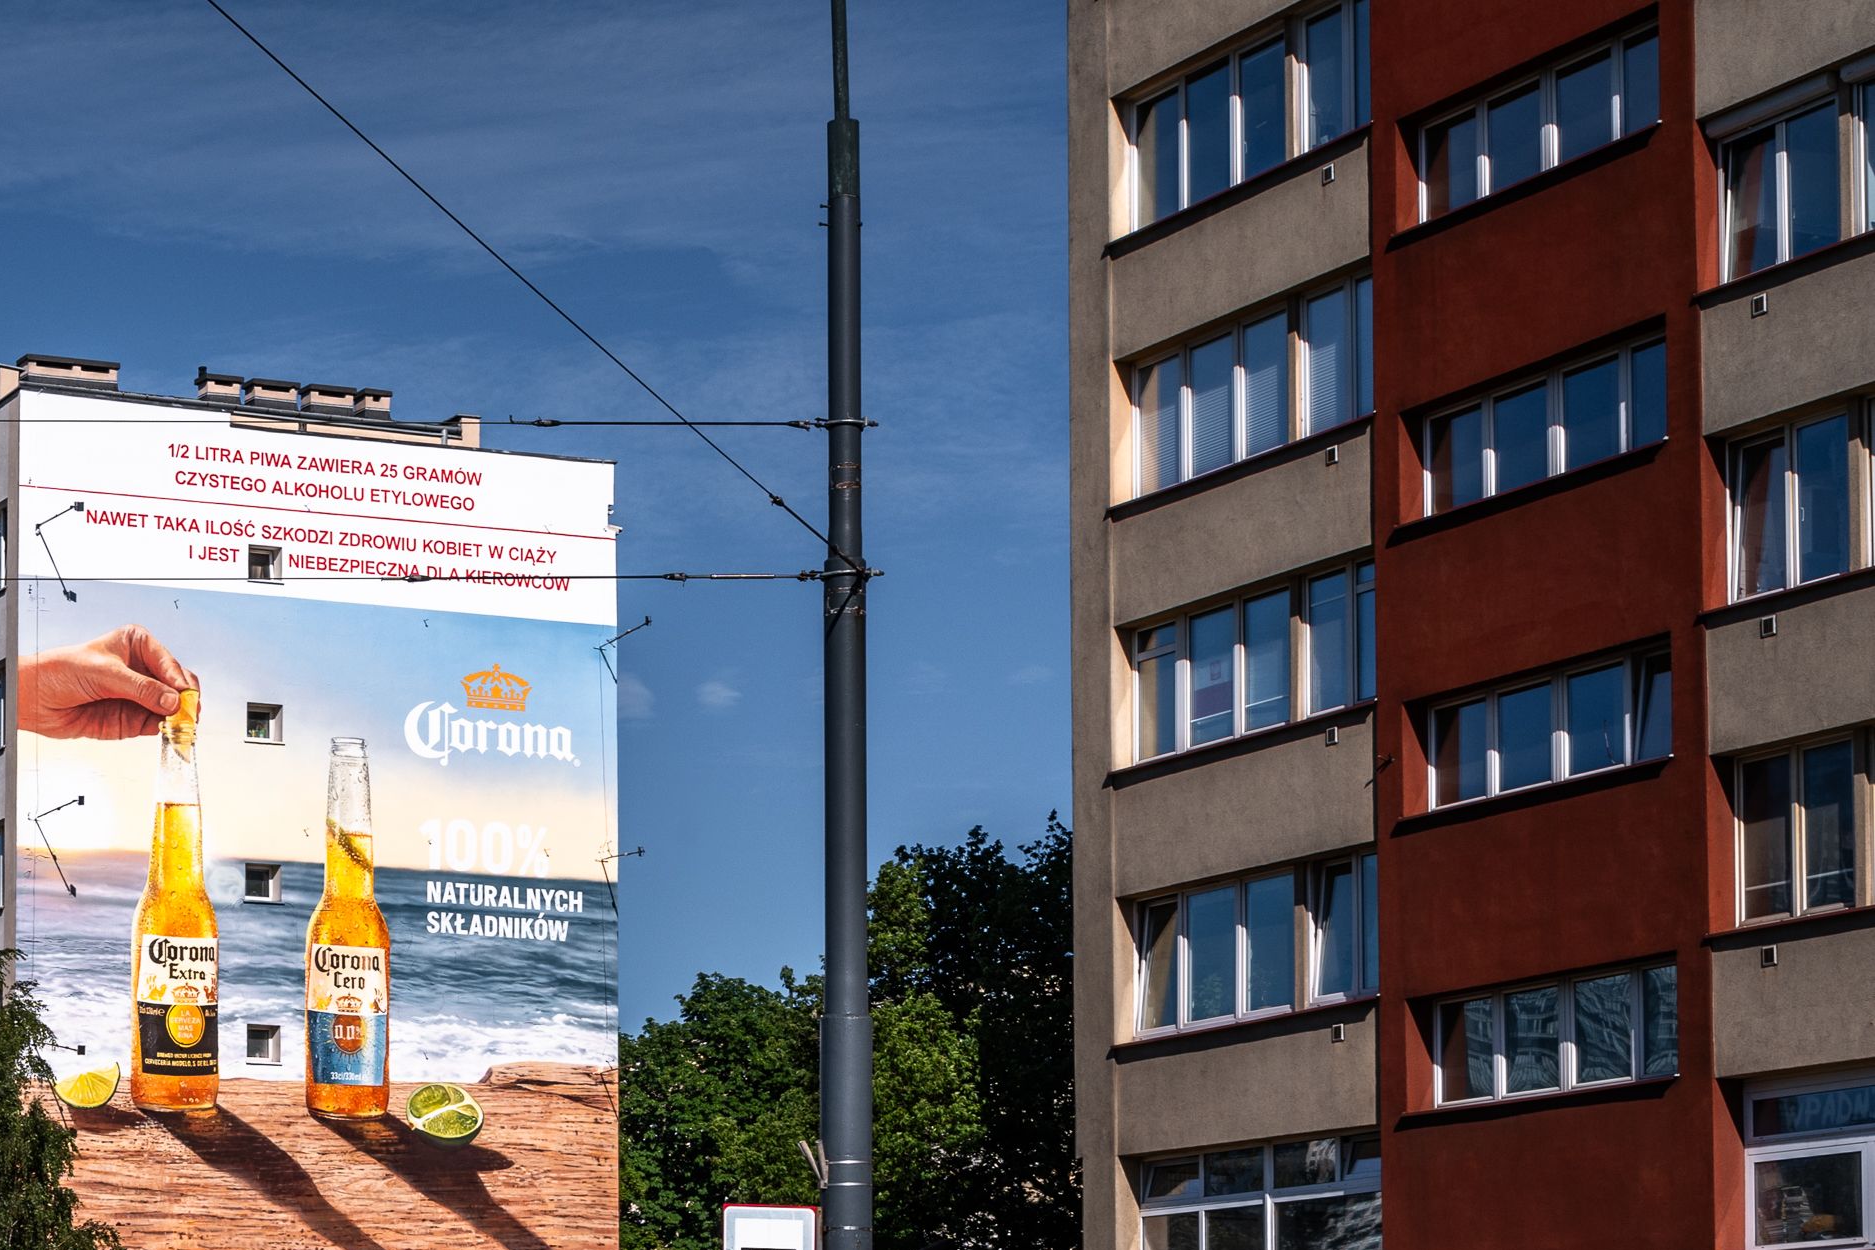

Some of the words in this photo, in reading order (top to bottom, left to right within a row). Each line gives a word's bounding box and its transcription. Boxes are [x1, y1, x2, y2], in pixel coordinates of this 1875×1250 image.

[168, 444, 189, 461] 1/2
[194, 445, 244, 464] LITRA
[249, 450, 292, 468] PIWA
[296, 453, 376, 476] ZAWIERA
[380, 462, 398, 478] 25
[403, 462, 483, 487] GRAMÓW
[175, 471, 267, 493] CZYSTEGO
[271, 480, 364, 502] ALKOHOLU
[370, 487, 475, 511] ETYLOWEGO
[86, 509, 149, 531] NAWET
[154, 516, 200, 534] TAKA
[205, 514, 256, 538] ILOŚĆ
[261, 524, 333, 546] SZKODZI
[338, 531, 417, 553] ZDROWIU
[423, 537, 483, 558] KOBIET
[487, 543, 505, 559] W
[508, 541, 557, 567] CIĄŻY
[189, 545, 193, 559] I
[198, 546, 240, 563] JEST
[288, 554, 421, 581] NIEBEZPIECZNA
[427, 565, 461, 583] DLA
[465, 568, 570, 592] KIEROWCÓW
[404, 701, 581, 766] Corona
[419, 818, 550, 878] 100%
[426, 881, 583, 913] NATURALNYCH
[426, 911, 569, 942] SKŁADNIKÓW
[149, 938, 215, 968] Corona
[315, 946, 381, 976] Corona
[168, 963, 206, 981] Extra
[333, 973, 366, 989] Cero
